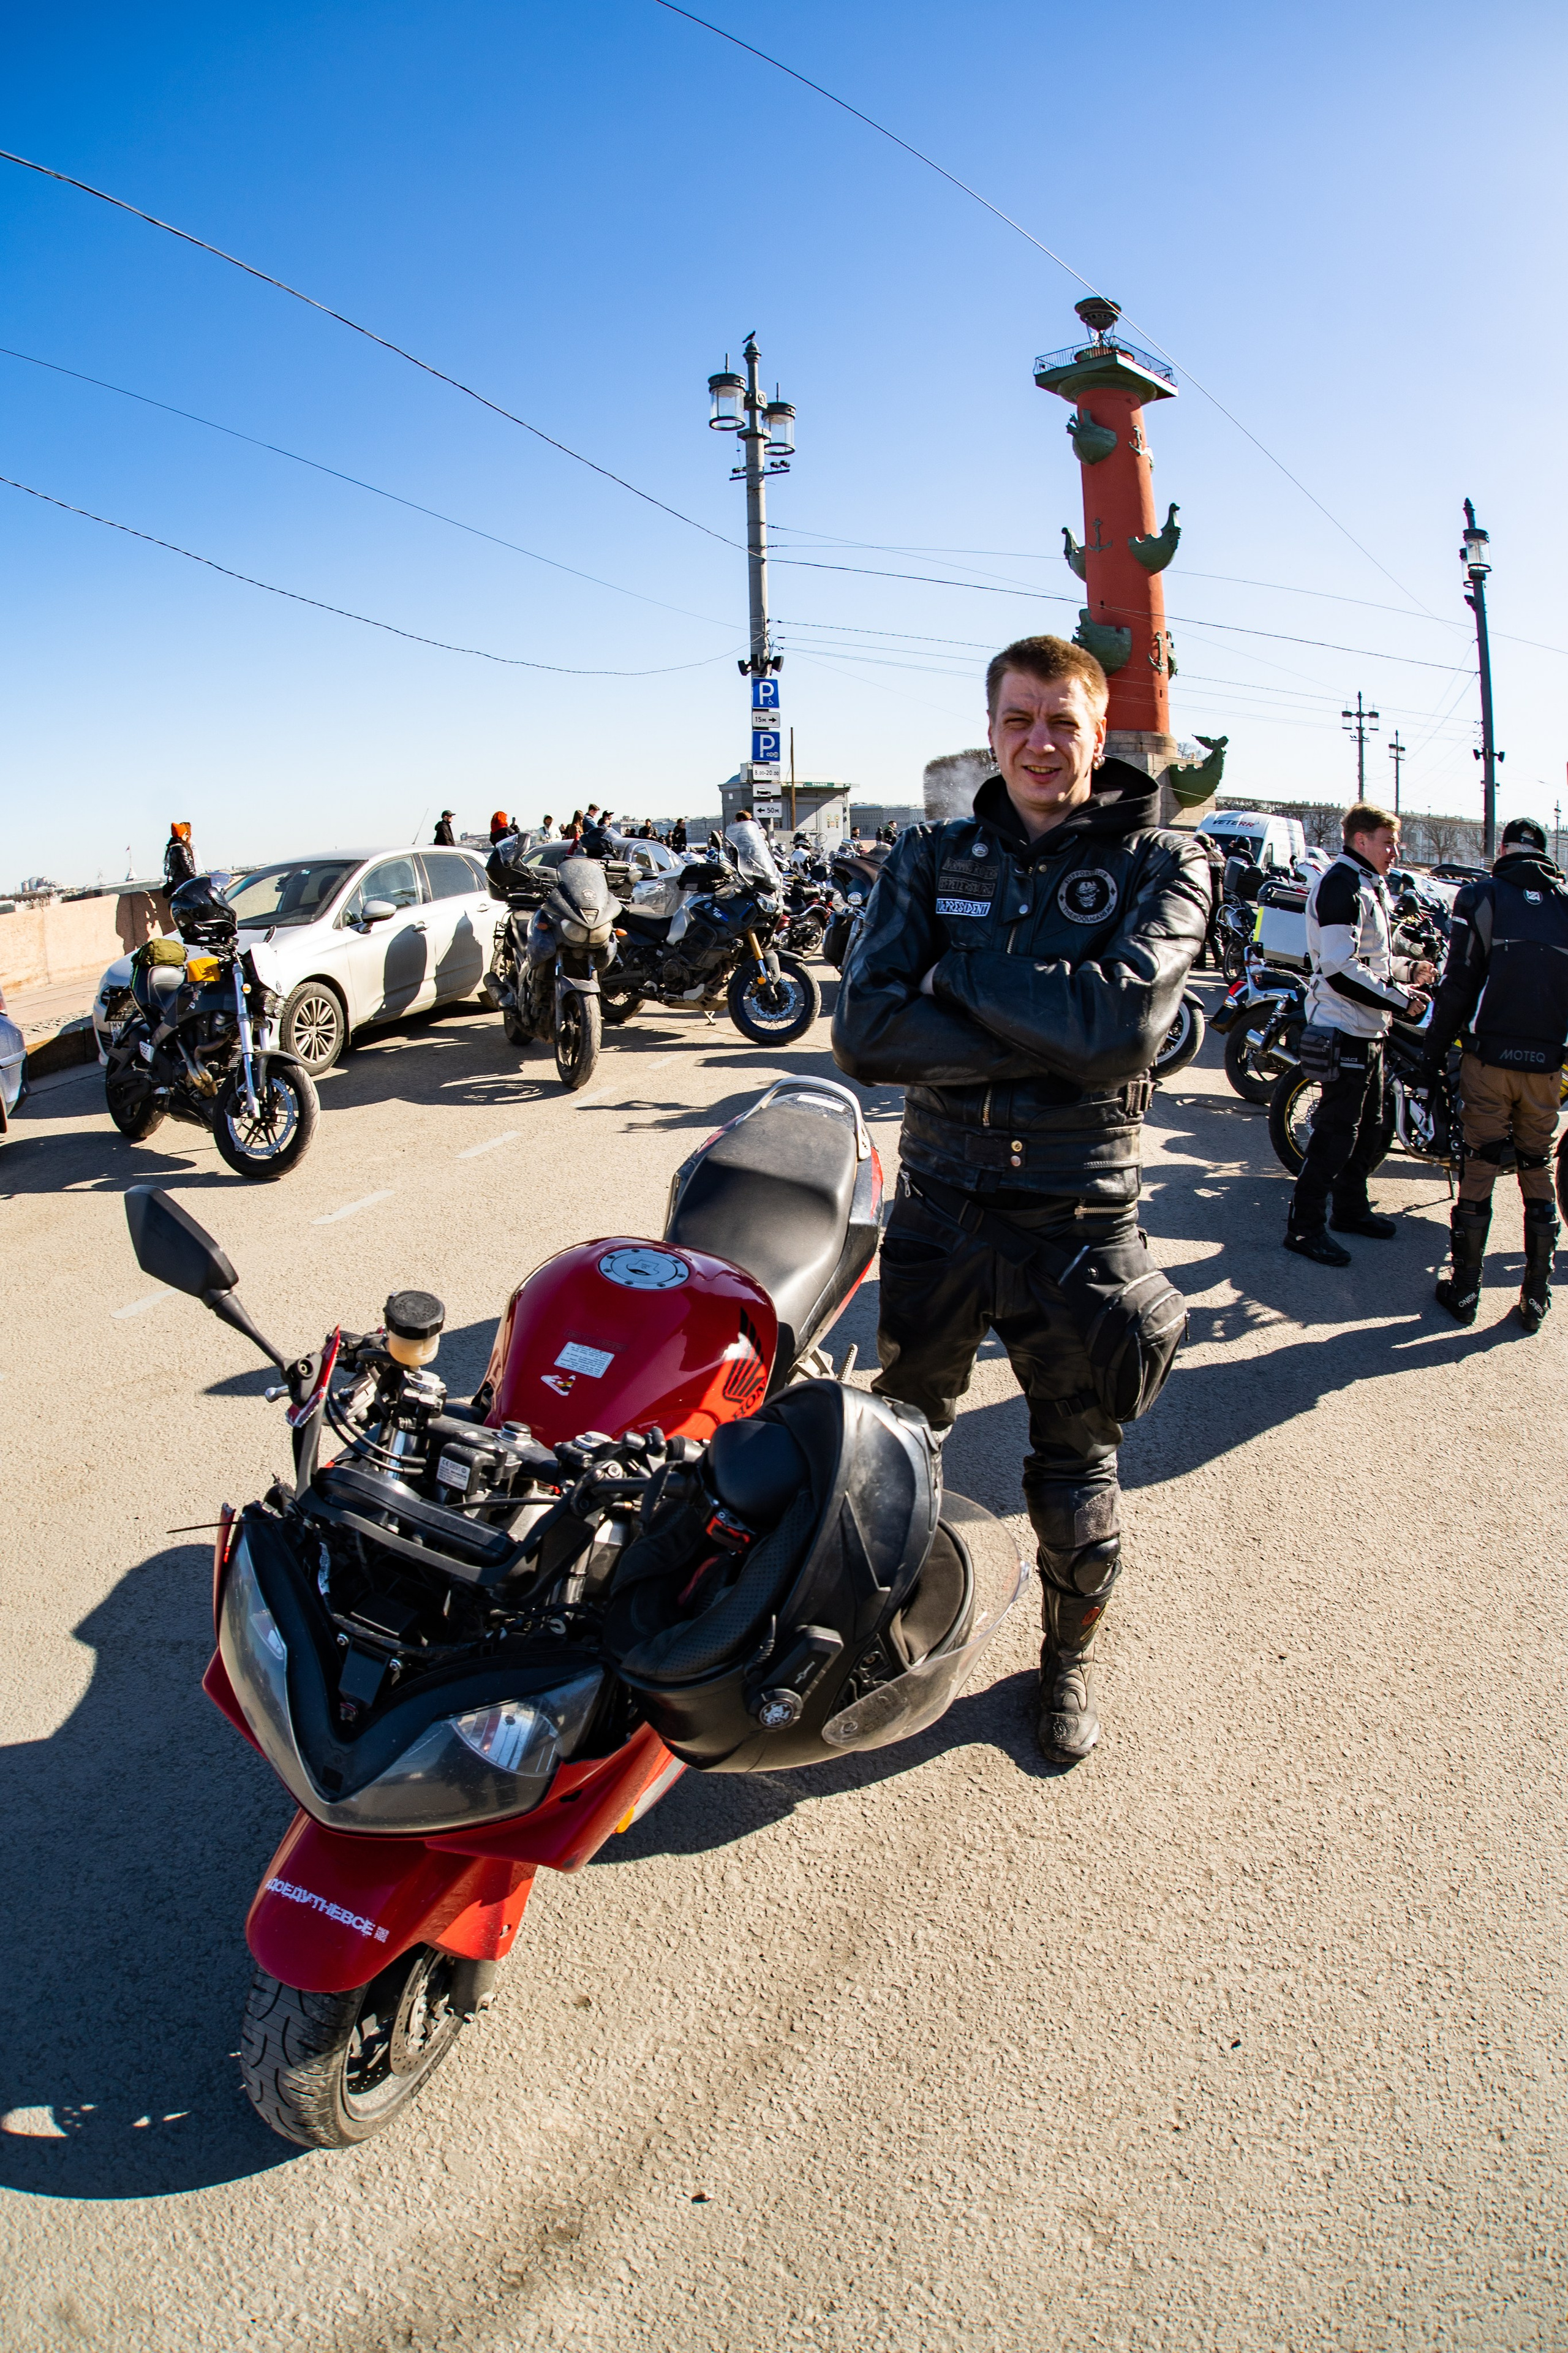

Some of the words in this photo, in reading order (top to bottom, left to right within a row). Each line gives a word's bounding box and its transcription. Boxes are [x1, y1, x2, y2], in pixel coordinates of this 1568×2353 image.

[759, 681, 774, 705] P
[760, 734, 775, 758] P
[1065, 871, 1093, 883] SUPPORT
[1499, 1049, 1546, 1064] MOTEQ
